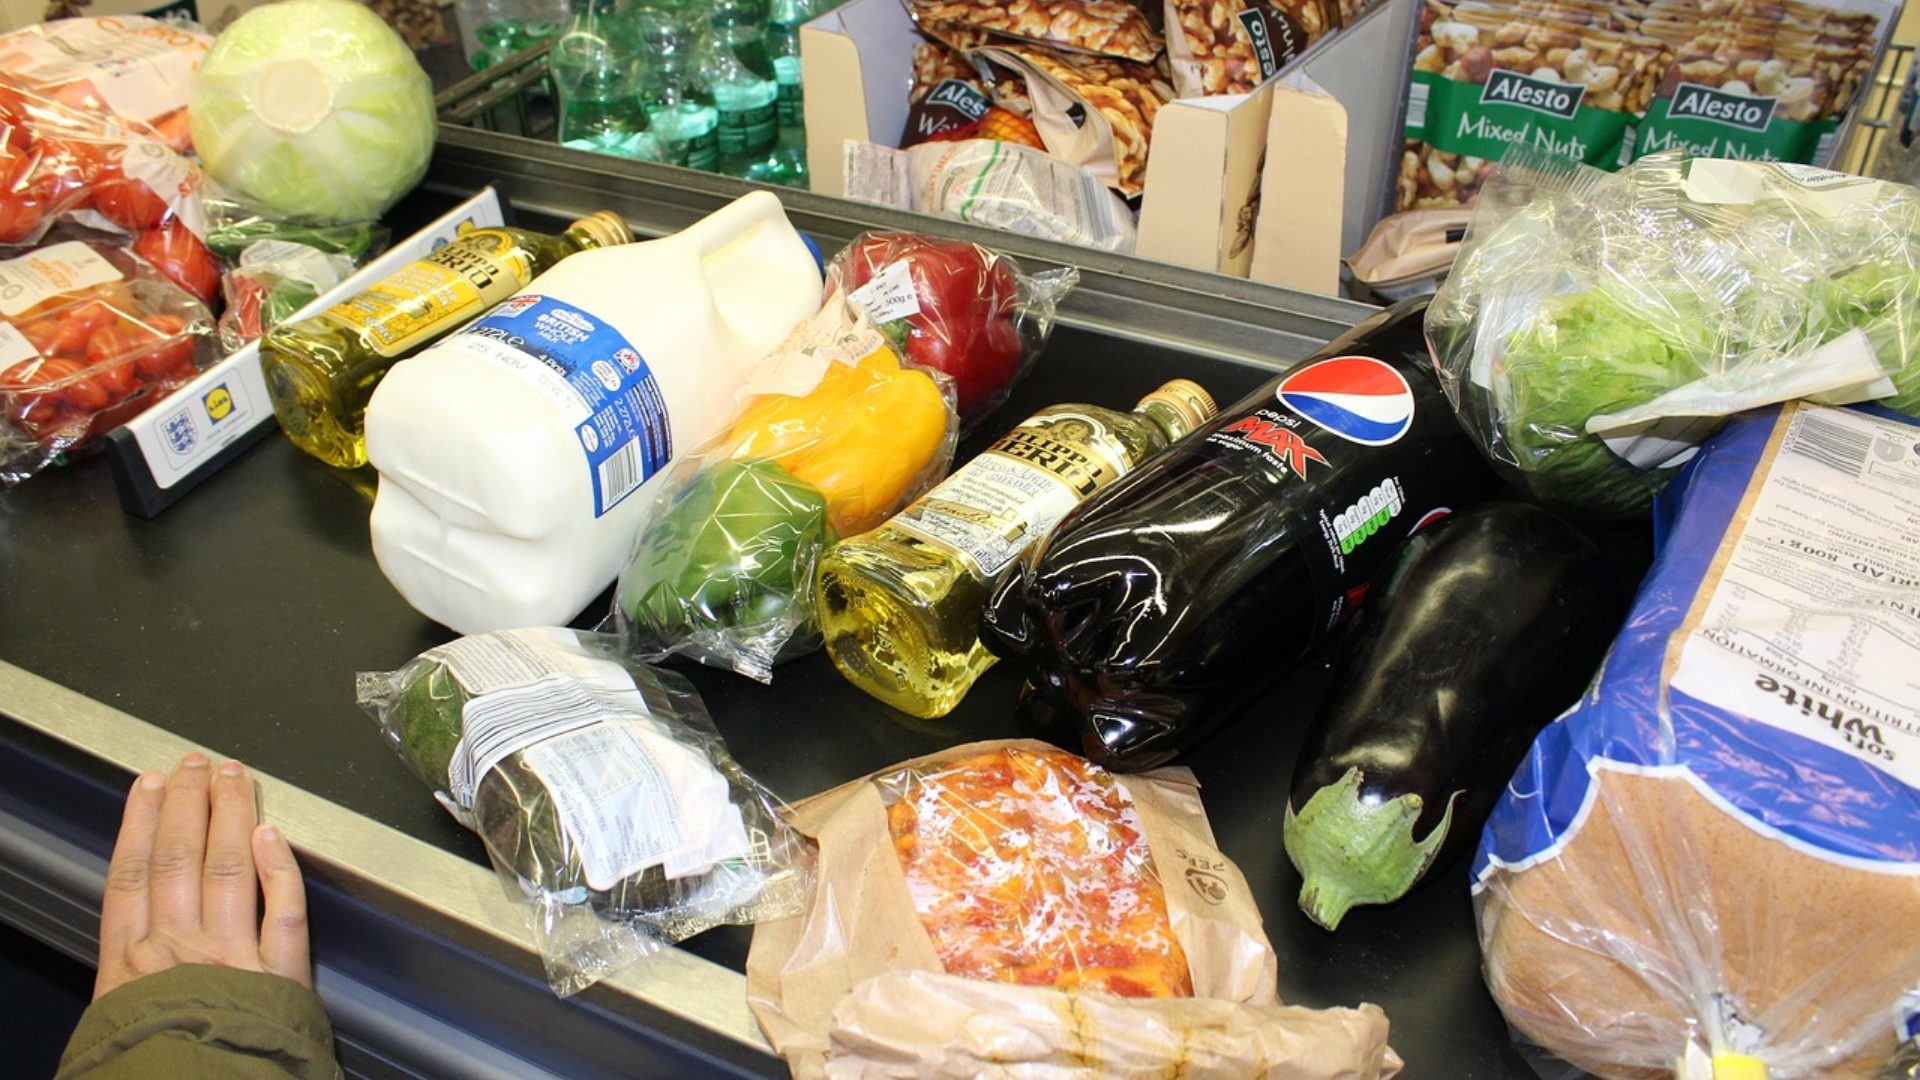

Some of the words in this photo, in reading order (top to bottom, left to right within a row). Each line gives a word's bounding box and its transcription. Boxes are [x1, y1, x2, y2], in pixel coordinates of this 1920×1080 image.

[1491, 78, 1570, 110] Alesto
[1678, 92, 1761, 123] Alesto
[1457, 112, 1530, 143] Mixed
[1534, 126, 1588, 160] Nuts
[1643, 127, 1718, 159] Mixed
[534, 321, 579, 345] WHOLE
[537, 314, 590, 342] BRITISH
[495, 352, 527, 370] NOV
[1255, 409, 1302, 429] pepsi
[1010, 432, 1103, 478] ILIPPO
[1211, 432, 1263, 455] maximum
[1262, 451, 1288, 474] taste
[1219, 415, 1333, 482] MAX
[992, 440, 1097, 496] ERIO
[1790, 539, 1839, 562] 800g
[1703, 628, 1831, 695] INFORMATION
[1755, 673, 1885, 745] White
[1836, 693, 1920, 735] TRITION
[1843, 730, 1896, 761] soft
